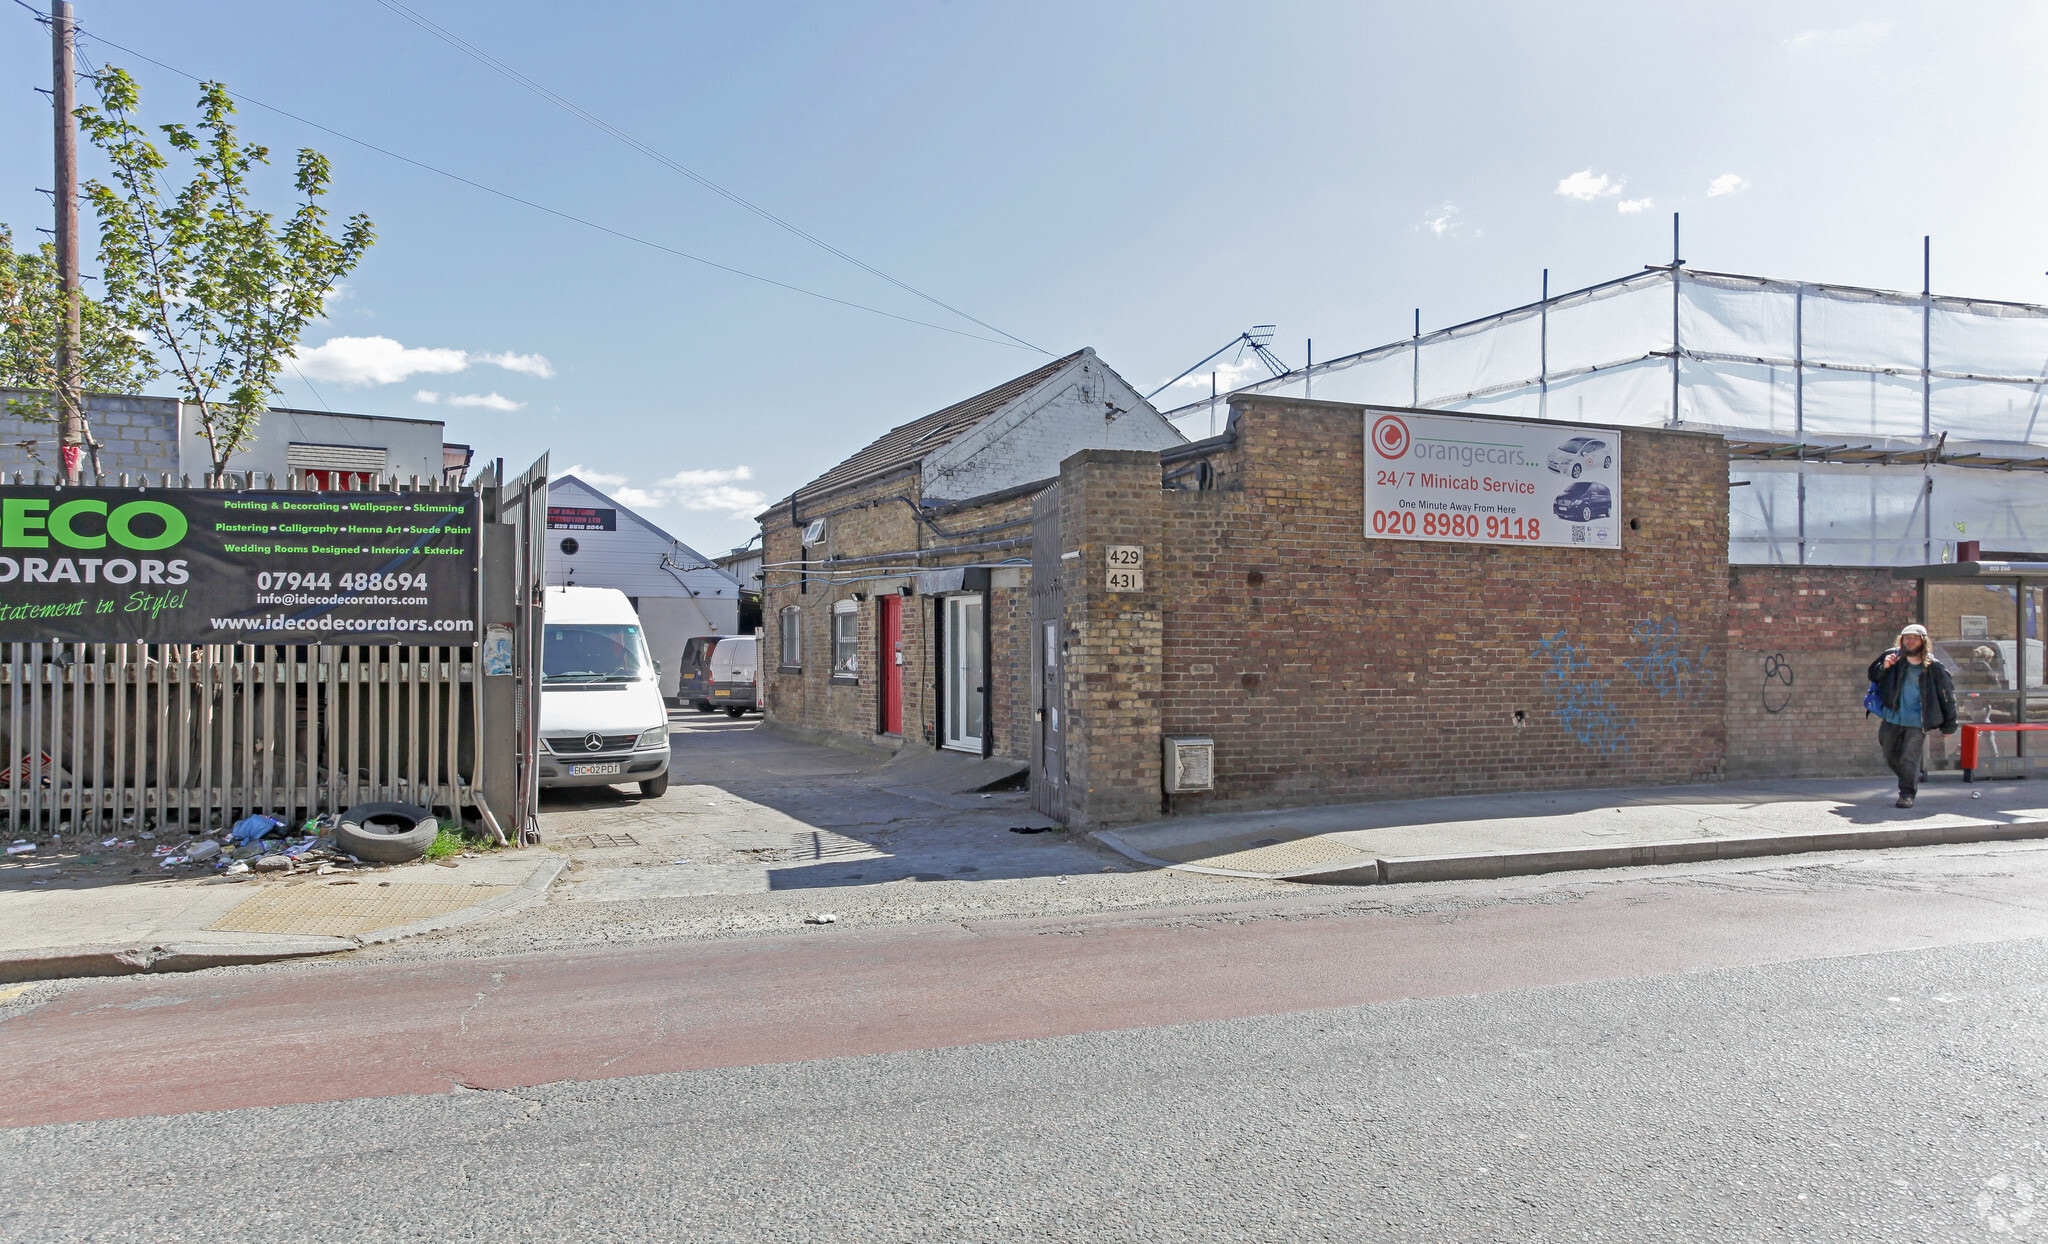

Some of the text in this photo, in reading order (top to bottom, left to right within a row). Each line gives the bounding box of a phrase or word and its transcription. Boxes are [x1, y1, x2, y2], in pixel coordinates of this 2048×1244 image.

[1377, 470, 1535, 495] 24/7 Minicab Service
[224, 501, 465, 514] Painting & Decorating Wallpaper Skimming
[1398, 499, 1516, 514] One Minute Away From Here
[0, 498, 188, 551] ECO
[216, 523, 472, 534] Plastering Calligraphy Henna Art Suede Paint
[1372, 510, 1540, 540] 020 8980 9118
[224, 544, 271, 554] Wedding
[274, 544, 309, 553] Rooms
[312, 545, 360, 555] Designed
[371, 546, 410, 554] Interior
[424, 546, 464, 555] Exterior
[1110, 550, 1139, 564] 429
[257, 572, 428, 591] 07944 488694
[1110, 574, 1135, 588] 431
[0, 590, 188, 621] tatement in Style!
[257, 593, 428, 606] info@idecodecorators.com
[210, 614, 474, 632] www.idecodecorators.com
